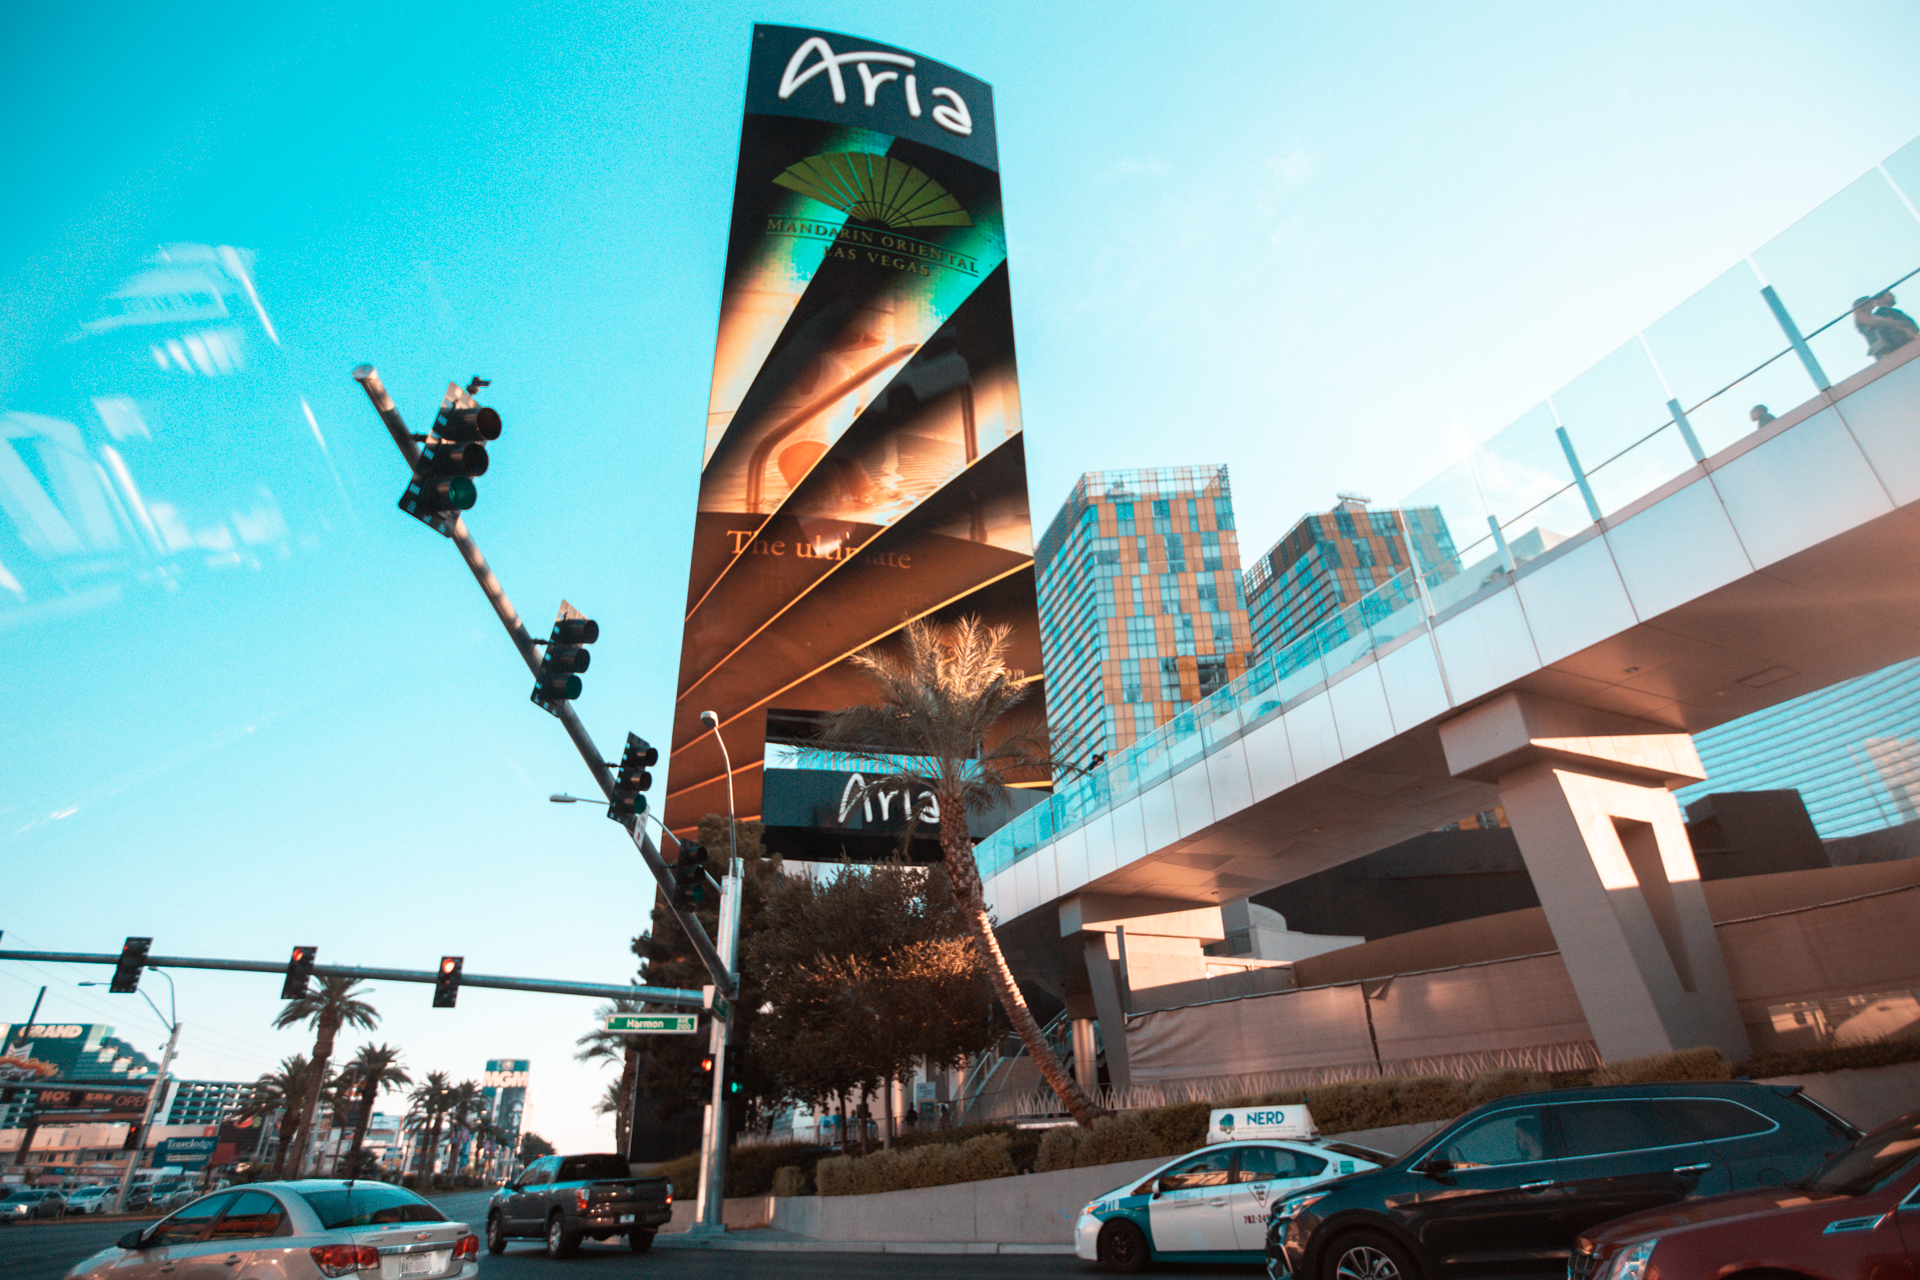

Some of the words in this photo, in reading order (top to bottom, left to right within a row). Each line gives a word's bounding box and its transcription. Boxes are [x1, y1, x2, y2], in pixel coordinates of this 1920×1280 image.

[778, 37, 972, 137] Aria
[766, 218, 873, 243] MANDARIN
[881, 236, 979, 273] ORIENTAL
[823, 245, 857, 260] LAS
[867, 252, 930, 277] VEGAS
[726, 530, 785, 556] The
[838, 773, 940, 823] Aria
[626, 1018, 664, 1029] Harmon
[482, 1071, 529, 1088] MGM
[1247, 1111, 1285, 1125] NERD
[167, 1138, 215, 1151] Travelodge
